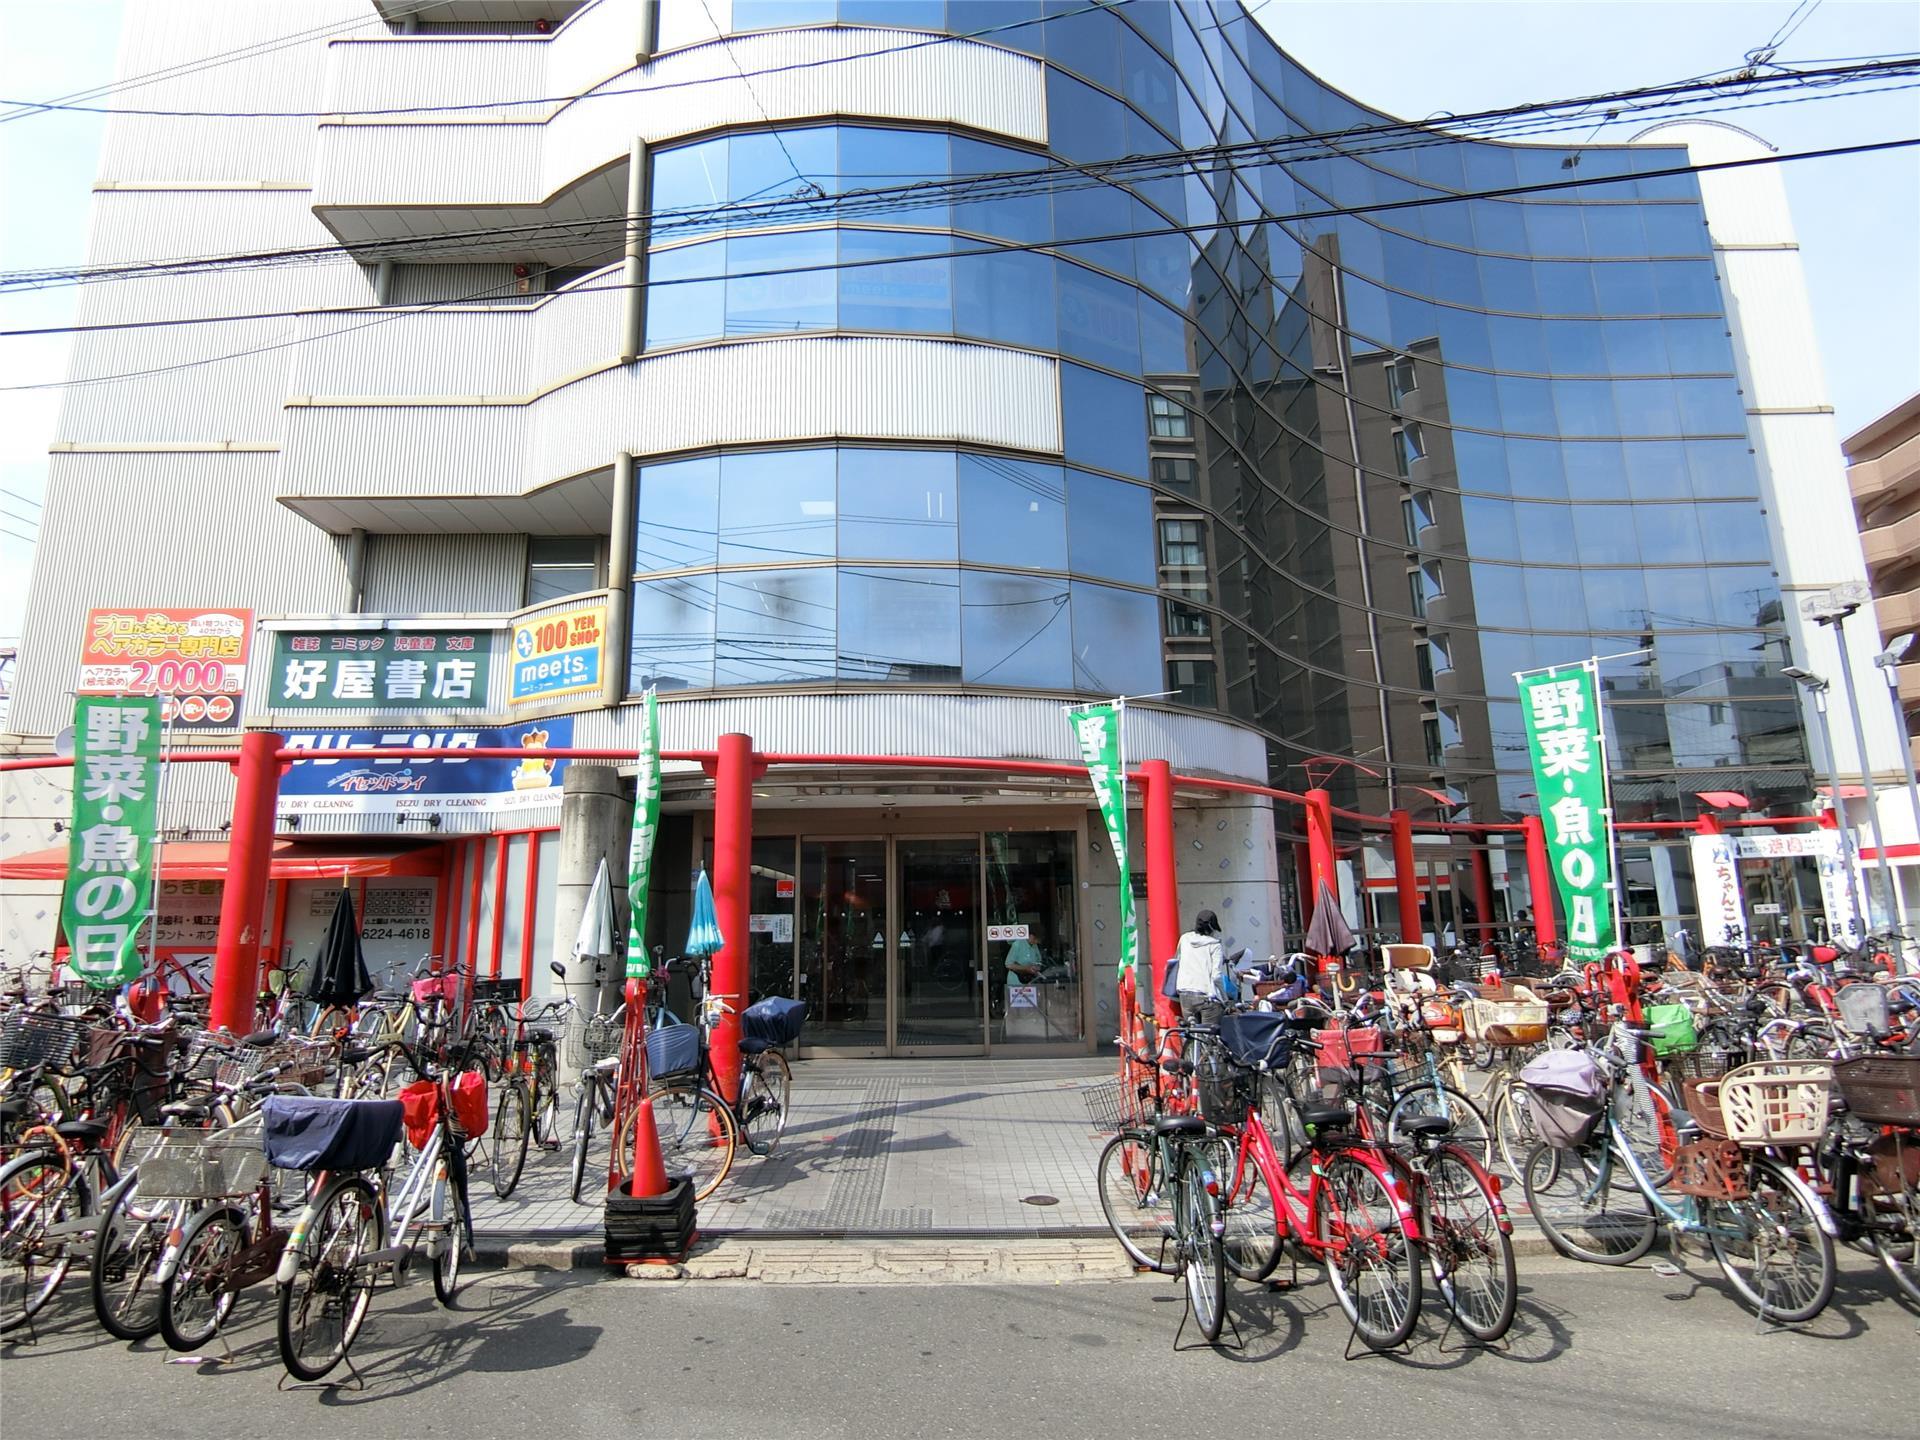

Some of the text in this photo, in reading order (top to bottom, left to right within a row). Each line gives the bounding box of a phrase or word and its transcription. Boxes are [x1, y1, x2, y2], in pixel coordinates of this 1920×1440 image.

[96, 614, 189, 636] プロが染める
[535, 615, 596, 653] 100 YEN
[90, 637, 241, 657] ヘアカラー専門店
[292, 637, 475, 651] 雑誌 コミック 児童書 文庫
[569, 628, 600, 647] SHOP
[85, 667, 128, 676] ヘアカラー
[283, 659, 477, 700] 好屋書店
[283, 732, 480, 765] クリーニング
[291, 800, 309, 809] DRY
[313, 800, 354, 808] CLEANING
[396, 798, 486, 808] ISEZU DRY CLEANING
[1529, 678, 1598, 944] 野菜・魚の日
[76, 705, 149, 972] 野菜・魚の日
[361, 928, 430, 940] 6224-4618
